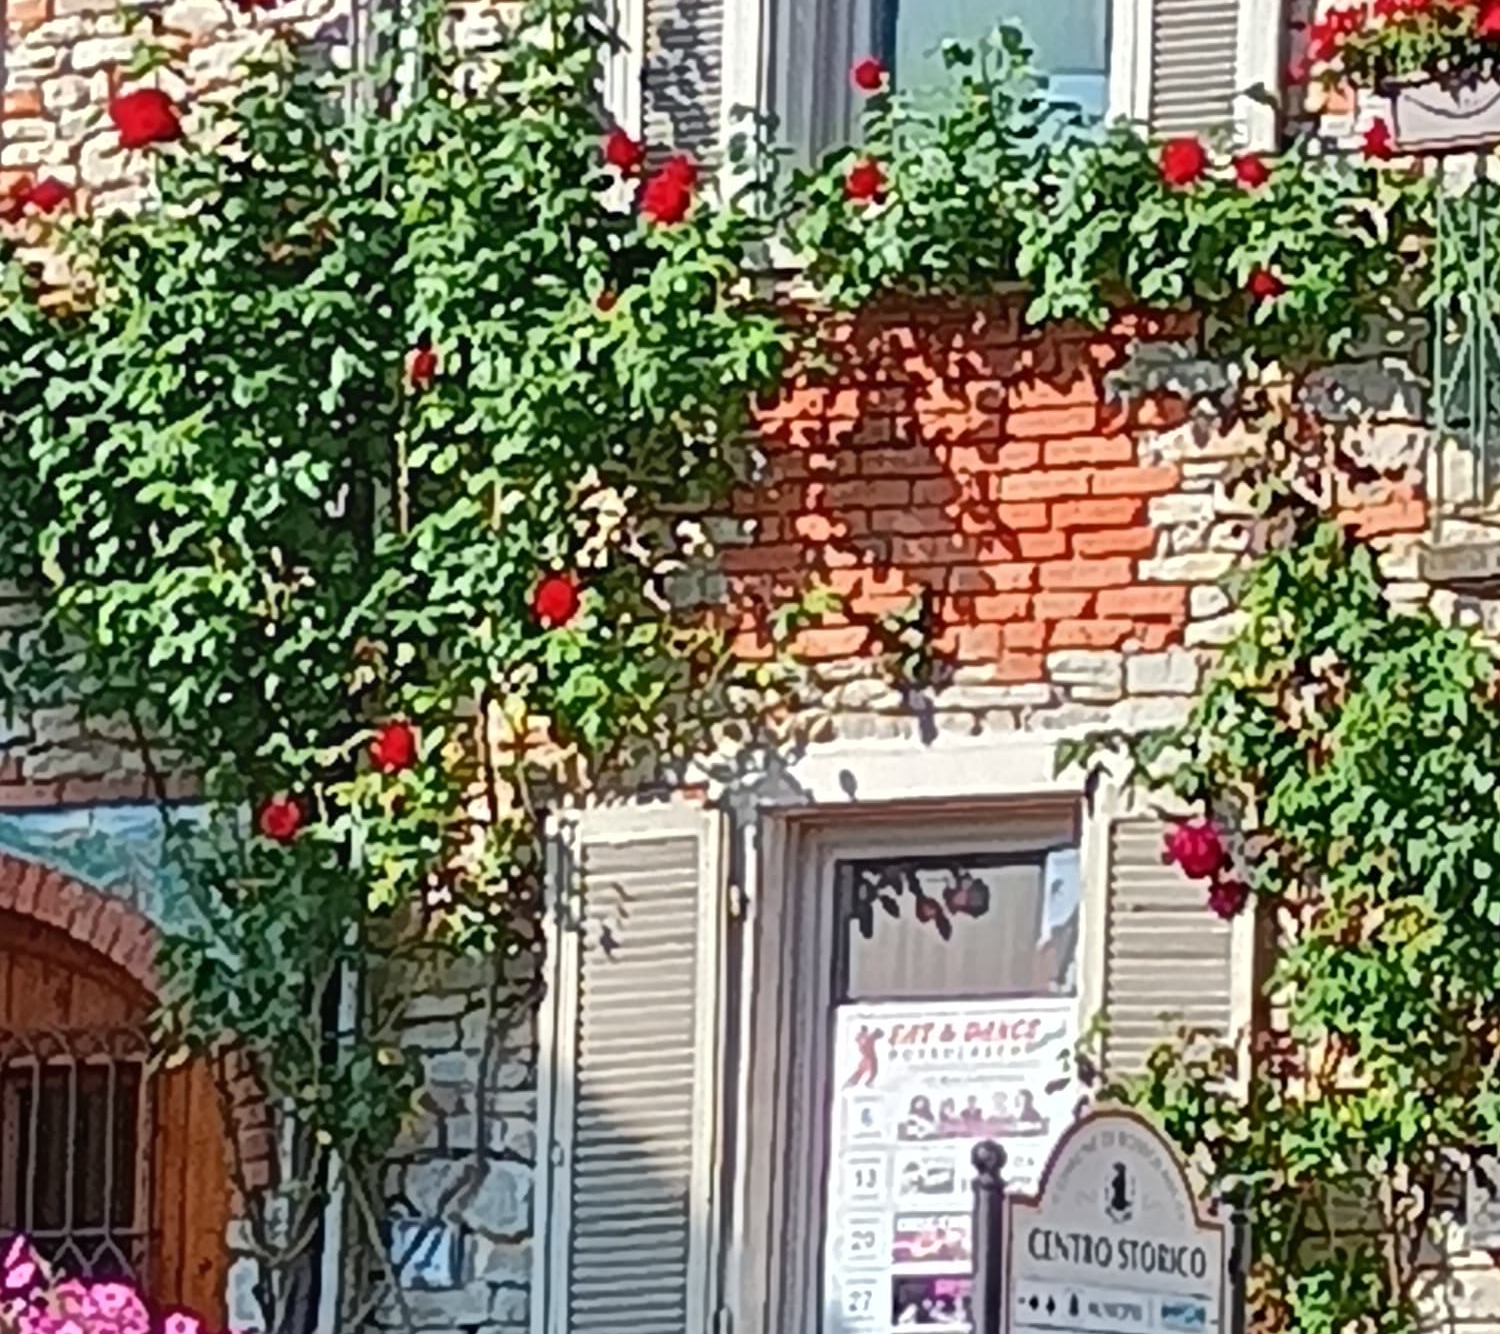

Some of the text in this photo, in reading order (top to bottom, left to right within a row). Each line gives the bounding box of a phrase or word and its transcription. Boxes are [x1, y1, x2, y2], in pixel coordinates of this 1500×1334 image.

[1028, 1226, 1207, 1280] CENTRO STORICO
[848, 1289, 873, 1312] 27
